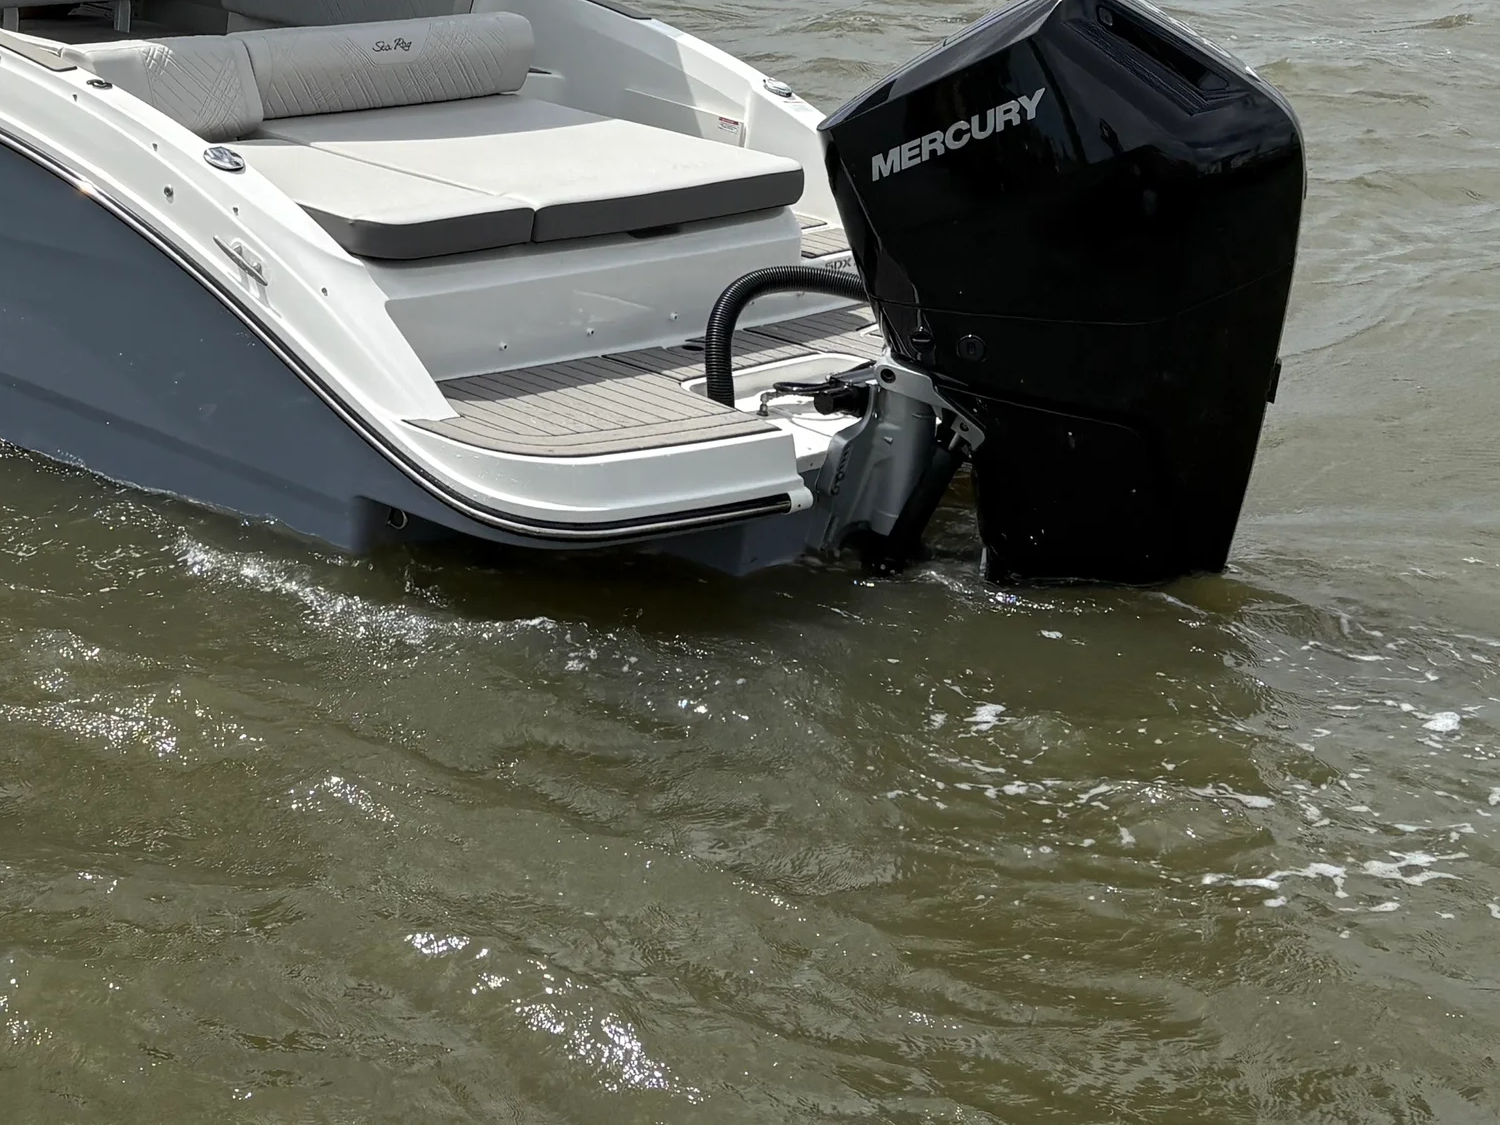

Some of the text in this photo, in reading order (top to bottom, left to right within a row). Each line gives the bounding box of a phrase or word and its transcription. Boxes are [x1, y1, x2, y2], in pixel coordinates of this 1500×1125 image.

[372, 38, 412, 52] Sea Ray
[871, 87, 1046, 182] MERCURY
